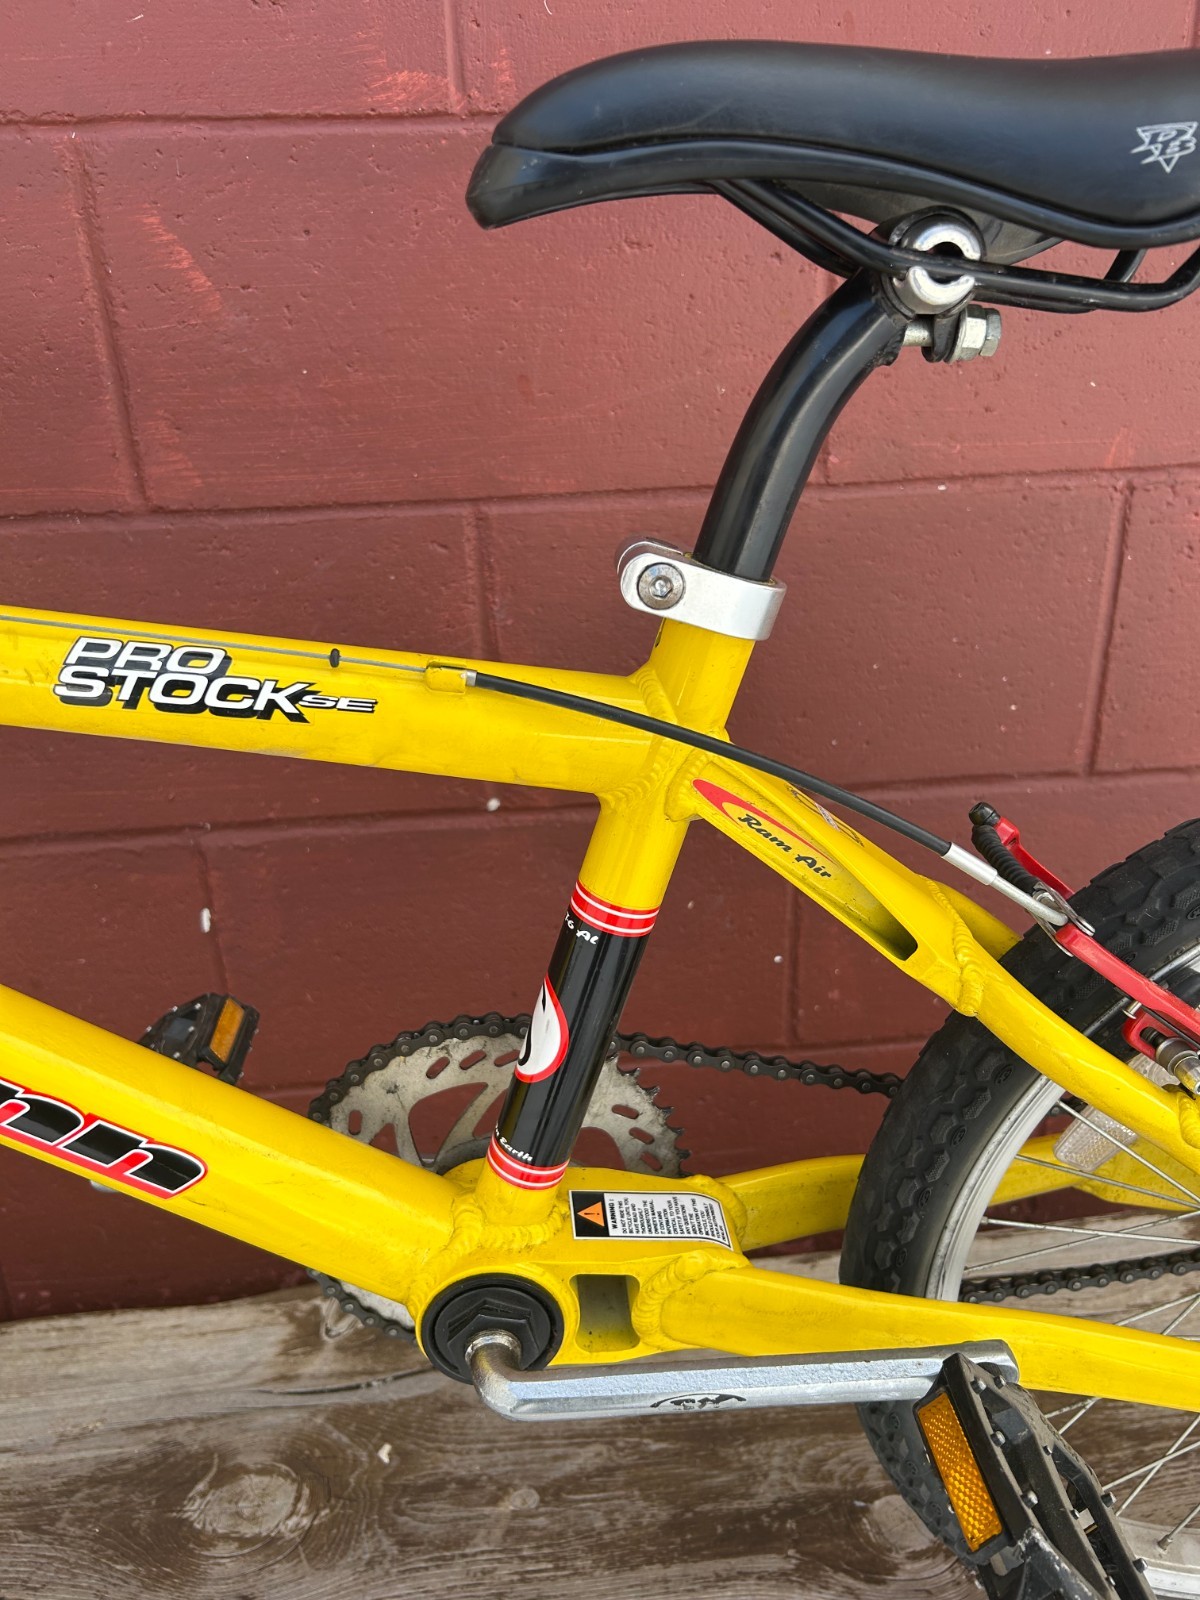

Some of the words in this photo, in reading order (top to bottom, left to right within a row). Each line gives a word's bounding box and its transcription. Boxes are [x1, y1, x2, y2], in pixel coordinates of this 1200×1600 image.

[63, 636, 232, 676] PRO
[53, 664, 316, 723] STOCK
[297, 693, 377, 713] SE
[737, 814, 792, 853] Ram
[795, 854, 832, 878] Air
[499, 1136, 533, 1162] Earth
[609, 1203, 618, 1229] WARNING
